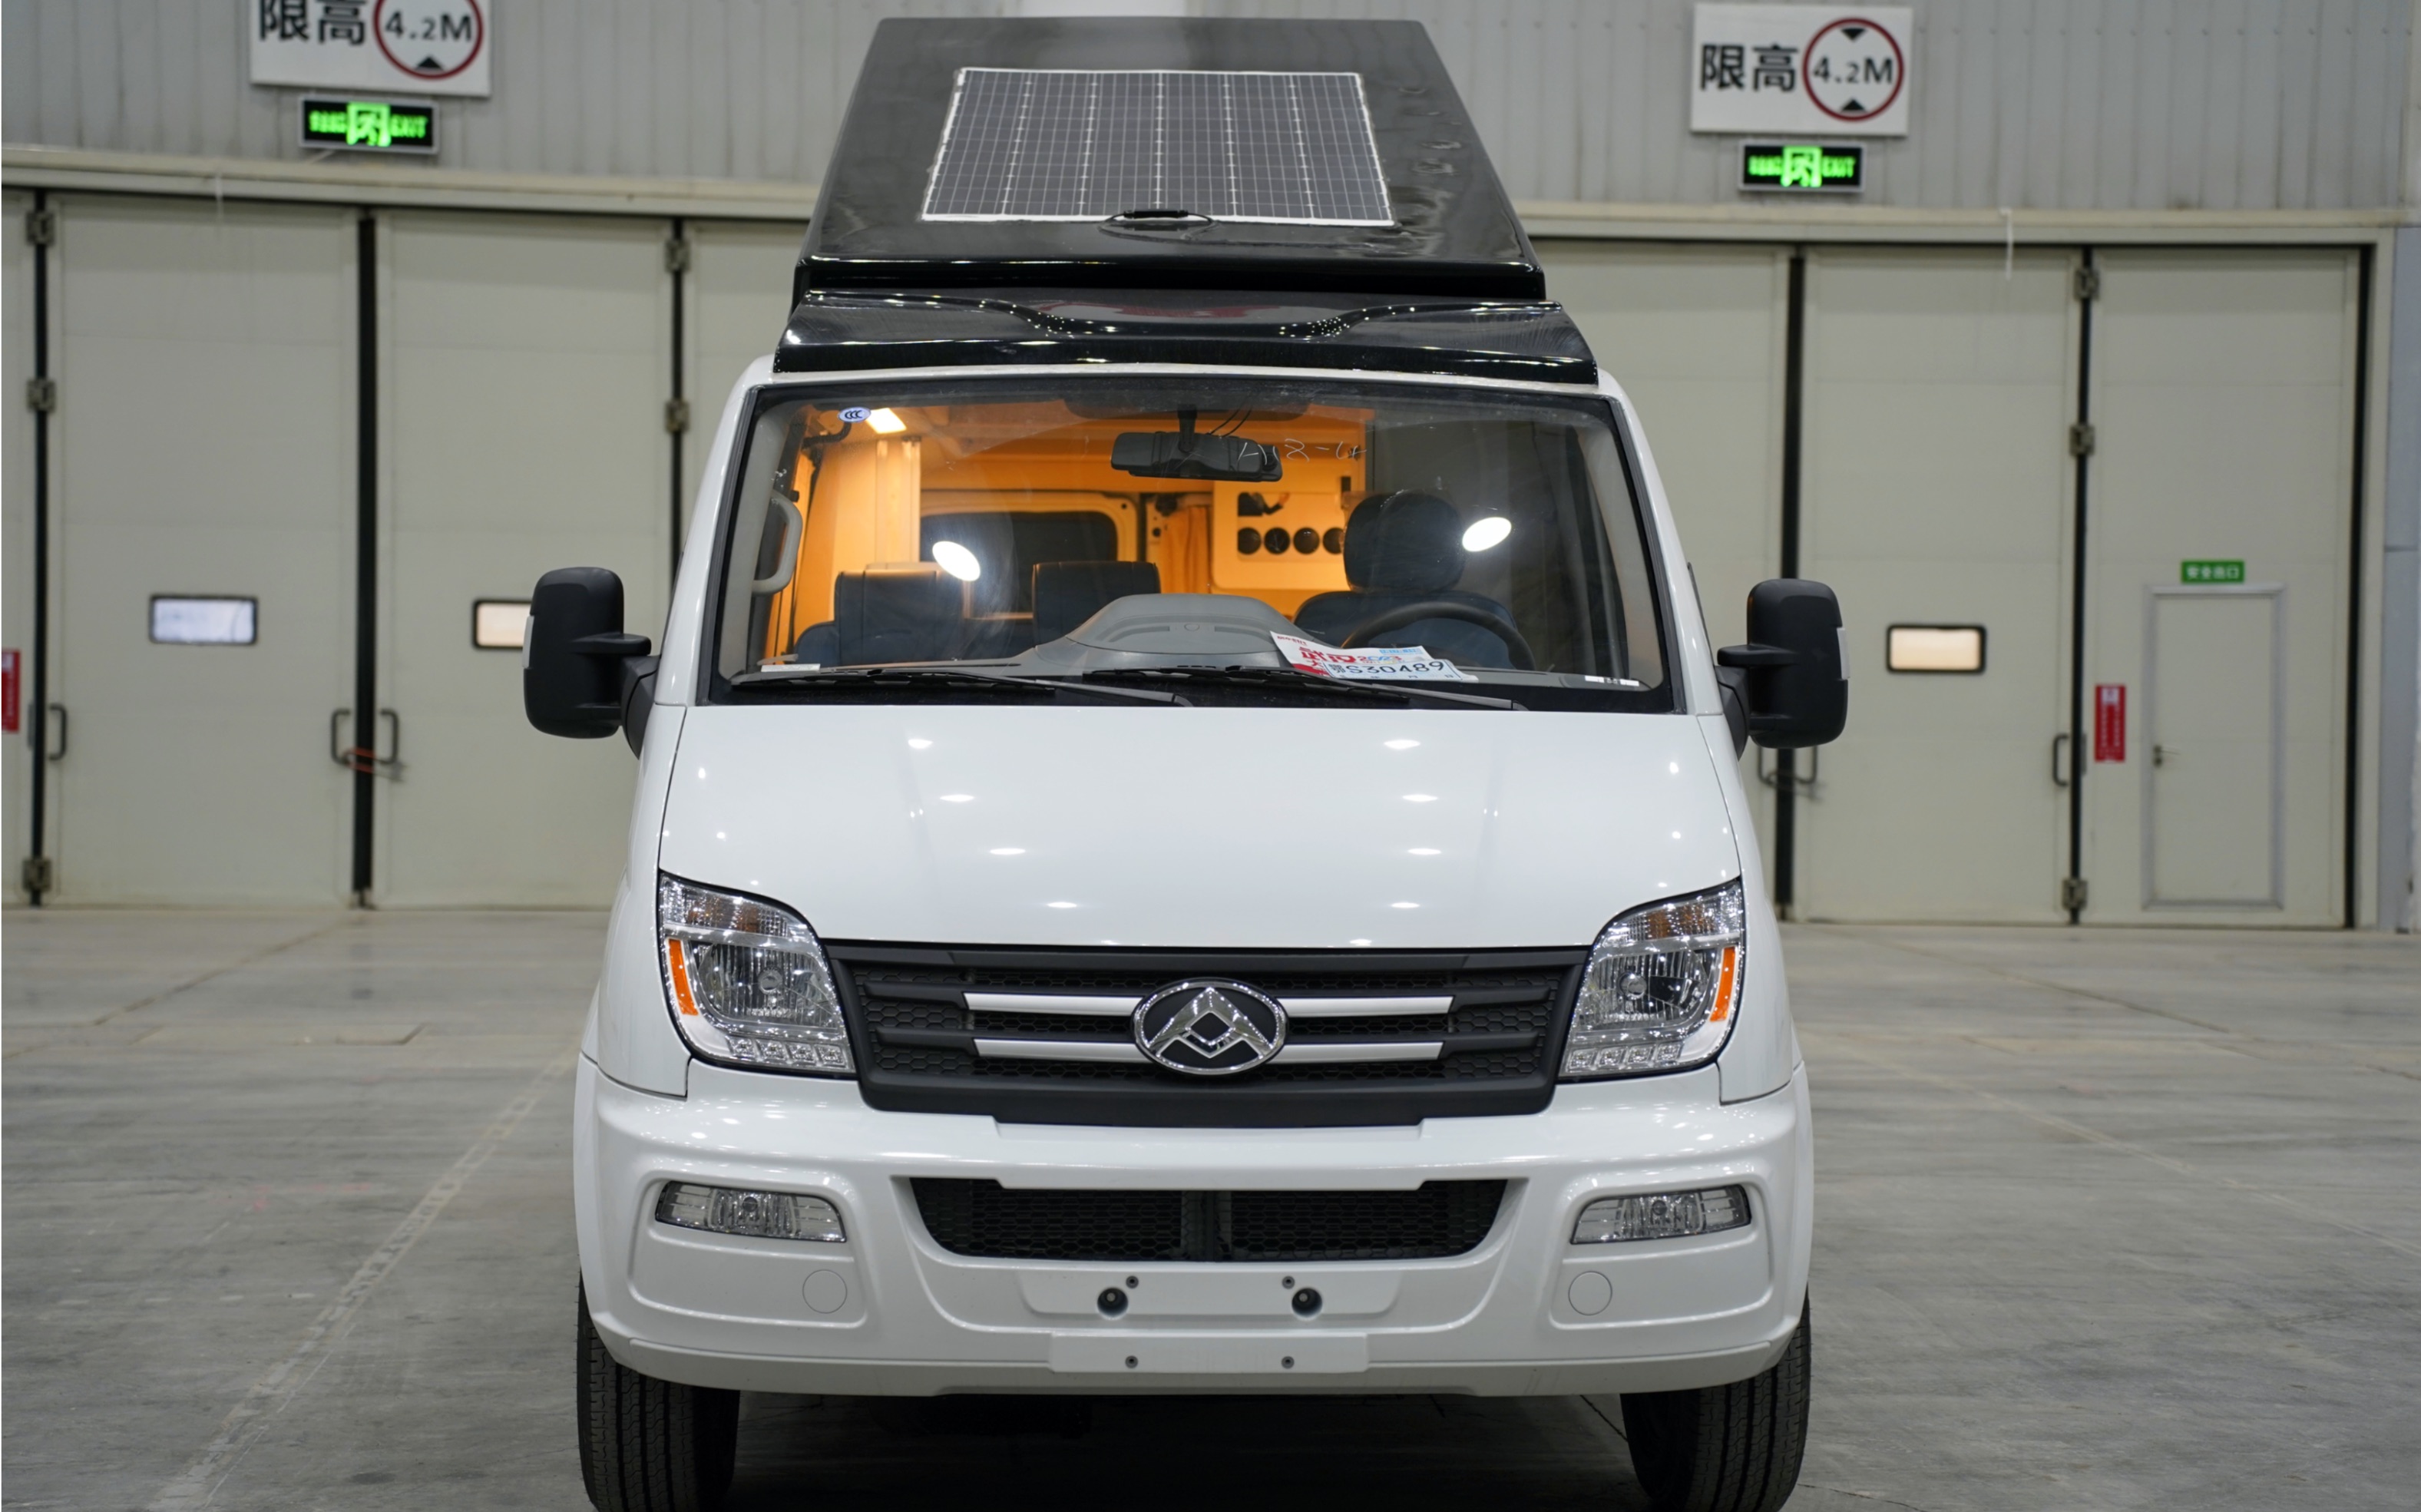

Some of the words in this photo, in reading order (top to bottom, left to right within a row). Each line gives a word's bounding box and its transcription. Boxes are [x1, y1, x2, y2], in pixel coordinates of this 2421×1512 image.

[259, 0, 365, 45] 限高
[385, 10, 472, 41] 4.2M
[1700, 43, 1799, 92] 限高
[1814, 55, 1893, 84] 4.2M
